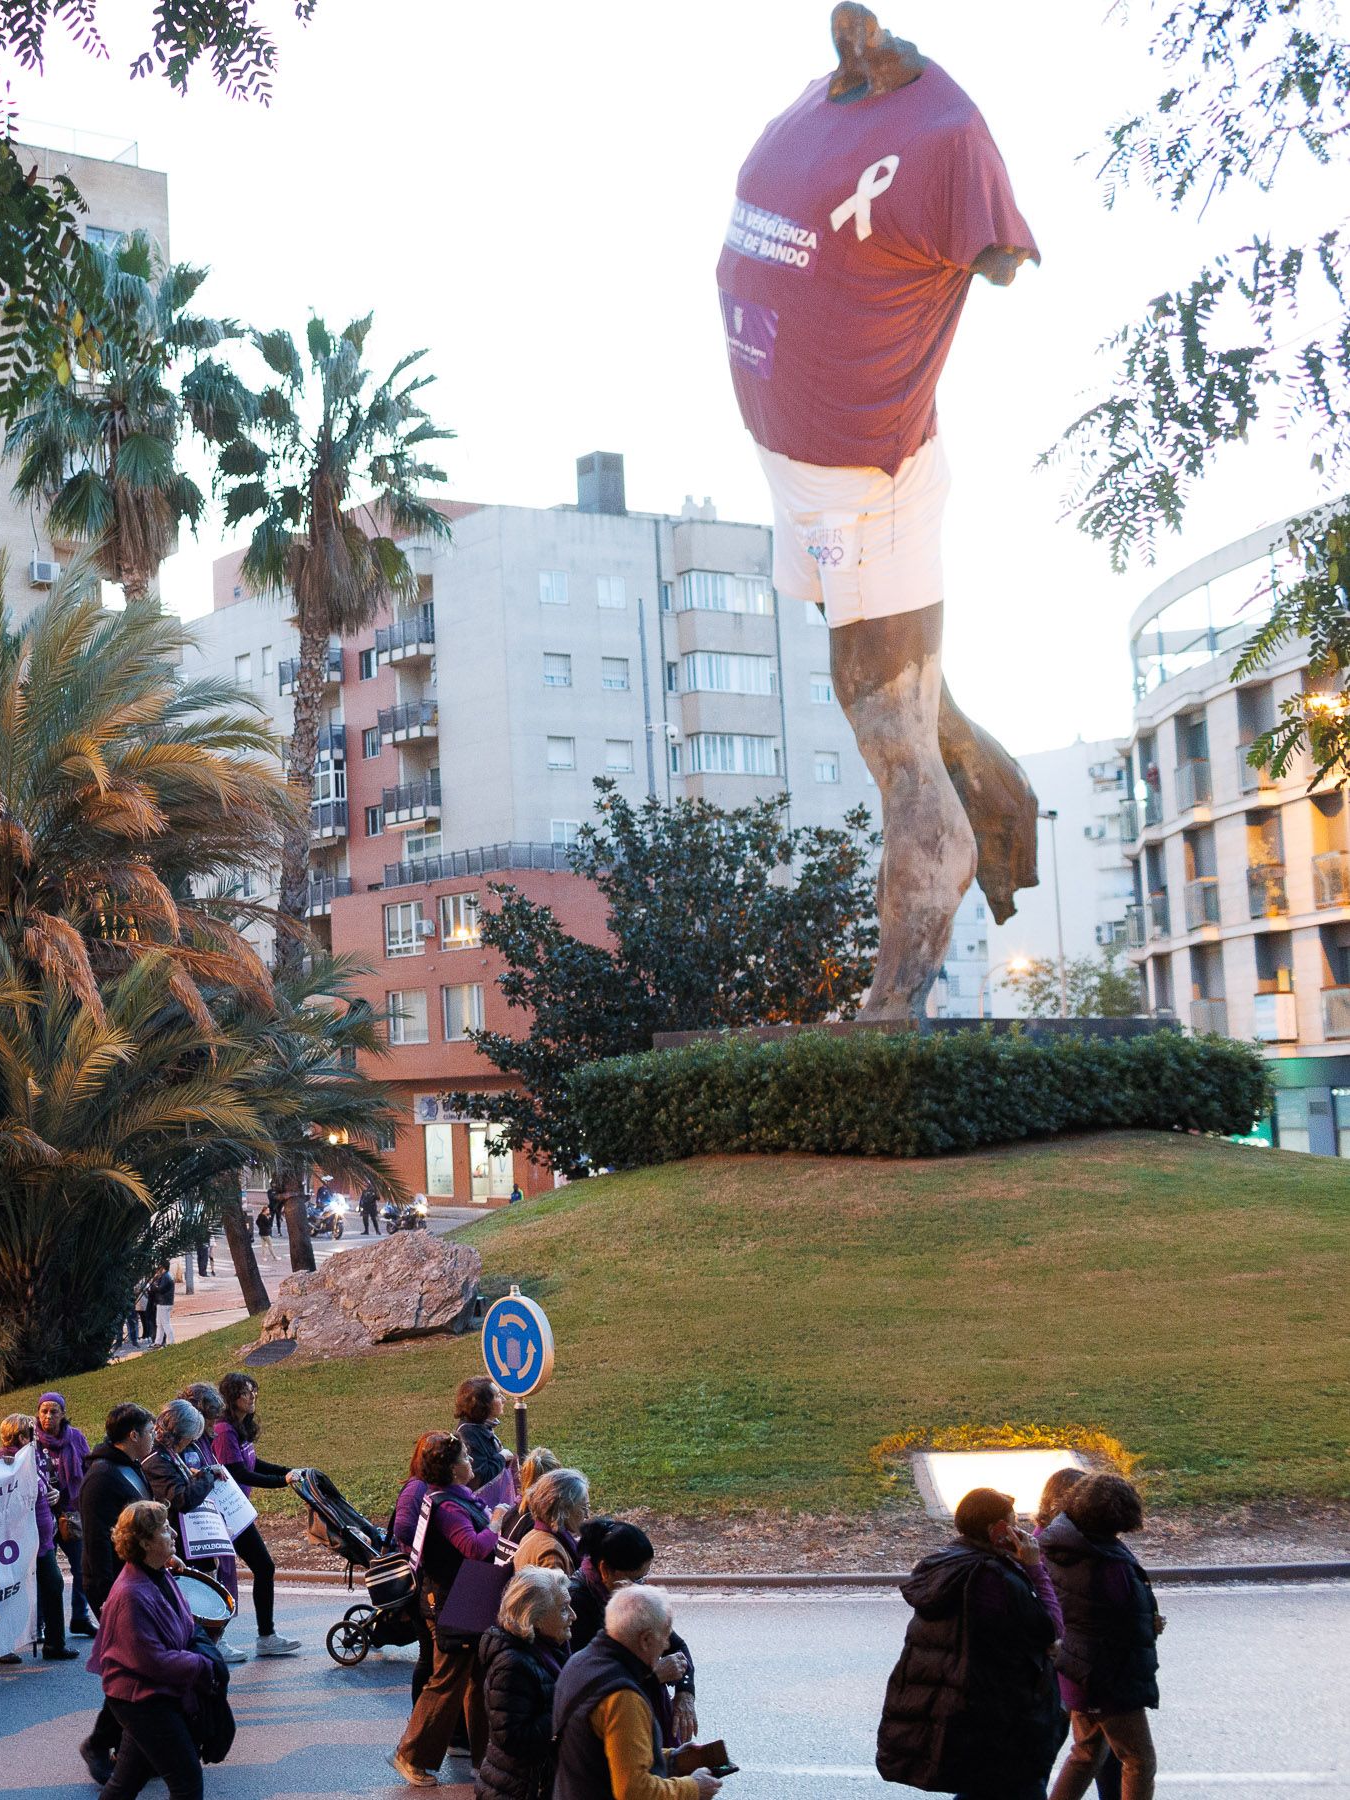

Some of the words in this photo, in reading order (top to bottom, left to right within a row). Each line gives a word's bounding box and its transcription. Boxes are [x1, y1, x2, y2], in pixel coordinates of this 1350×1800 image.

[745, 210, 817, 250] VERGÜENZA
[759, 239, 810, 268] BANDO
[190, 1544, 202, 1552] STOP
